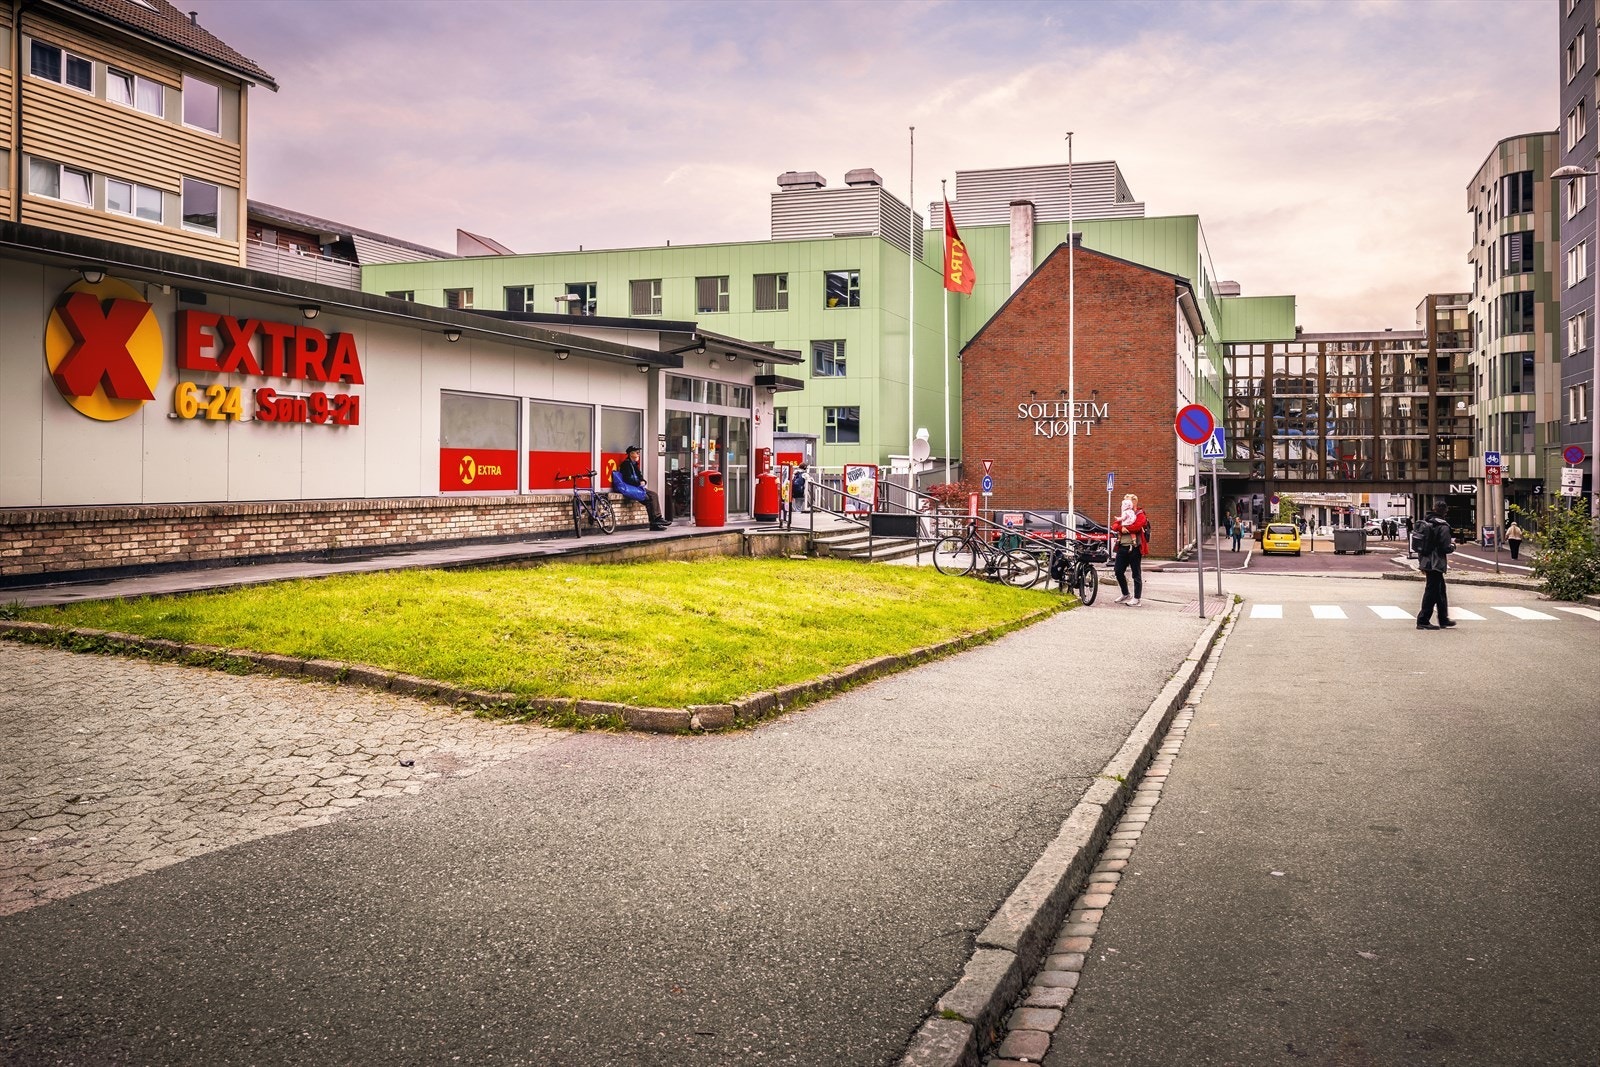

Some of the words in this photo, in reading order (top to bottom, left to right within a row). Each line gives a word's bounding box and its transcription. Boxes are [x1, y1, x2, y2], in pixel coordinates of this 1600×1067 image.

[177, 309, 364, 385] EXTRA
[175, 381, 243, 421] 6-24
[255, 387, 307, 423] Søn
[309, 391, 360, 426] 9-21
[1017, 402, 1110, 419] SOLHEIM
[1034, 419, 1095, 439] KJØTT
[478, 465, 502, 476] EXTRA
